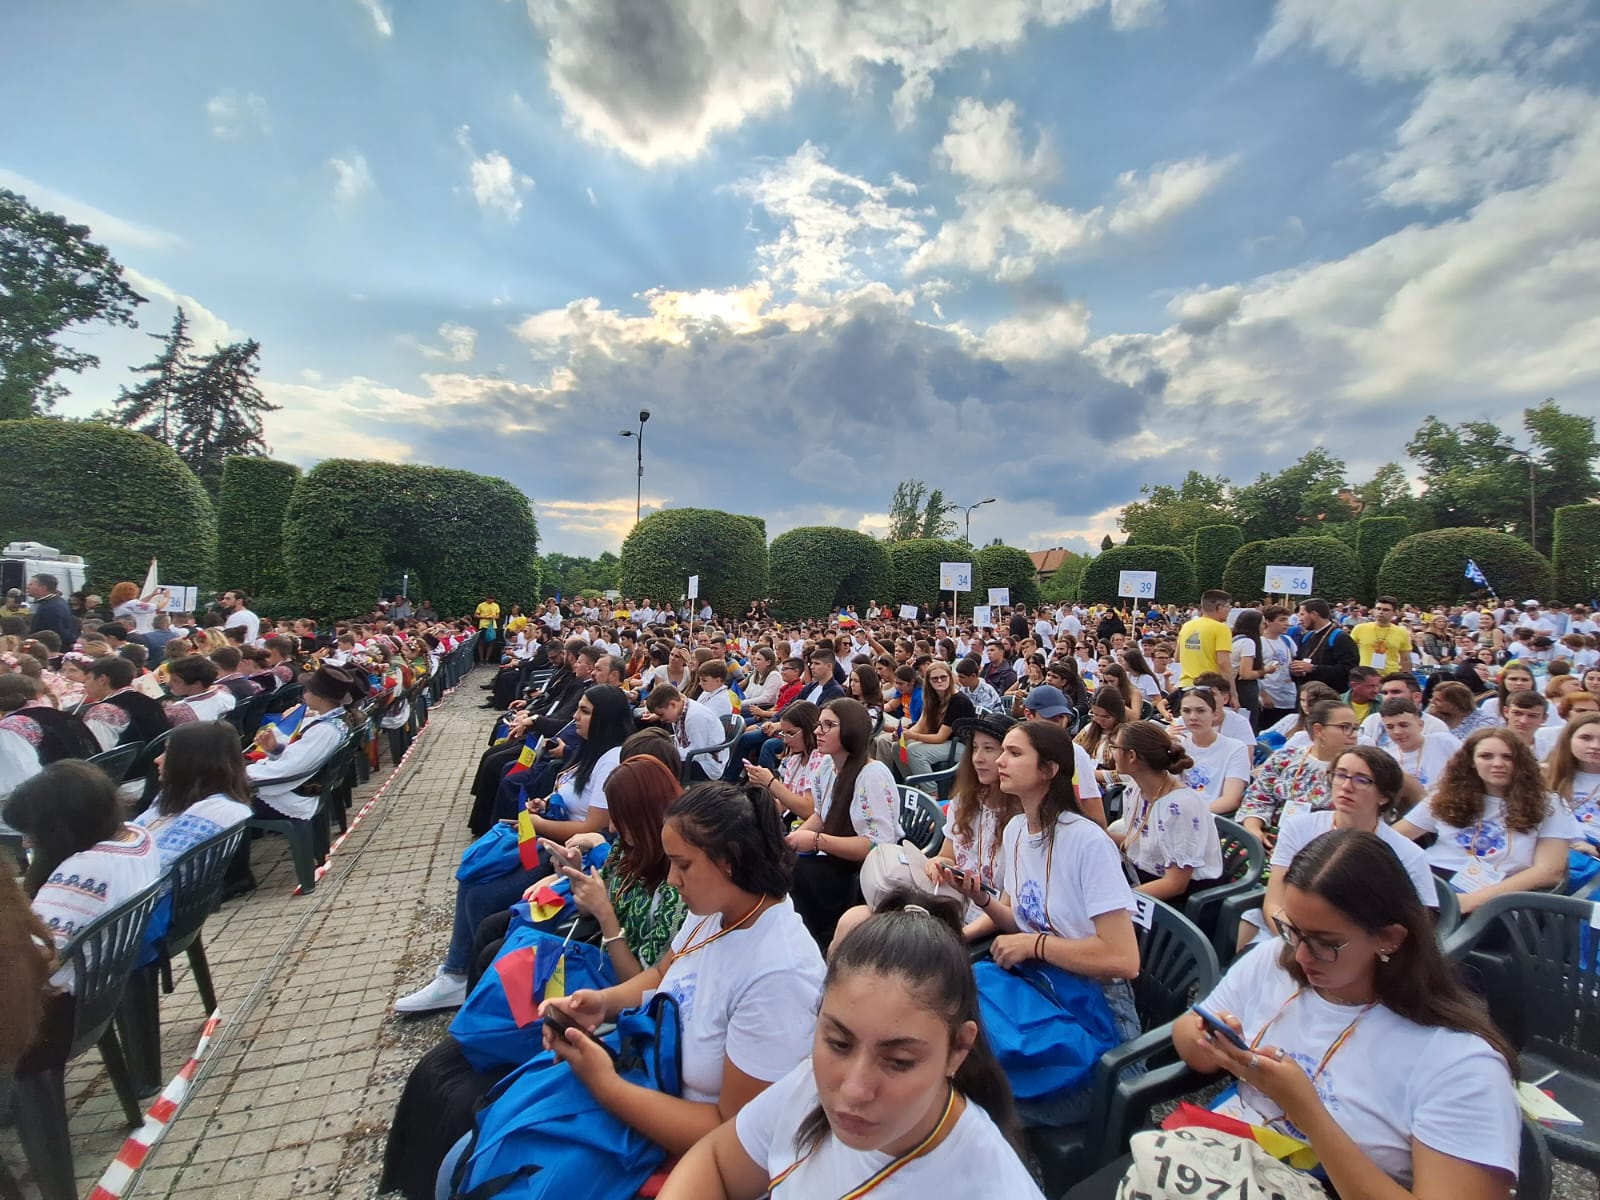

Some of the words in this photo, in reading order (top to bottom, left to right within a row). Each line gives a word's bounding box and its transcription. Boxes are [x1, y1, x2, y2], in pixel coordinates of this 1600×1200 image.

[957, 574, 968, 586] 34
[1292, 577, 1308, 590] 56
[1139, 582, 1152, 593] 39
[908, 794, 915, 806] E
[1154, 1155, 1249, 1200] 1971
